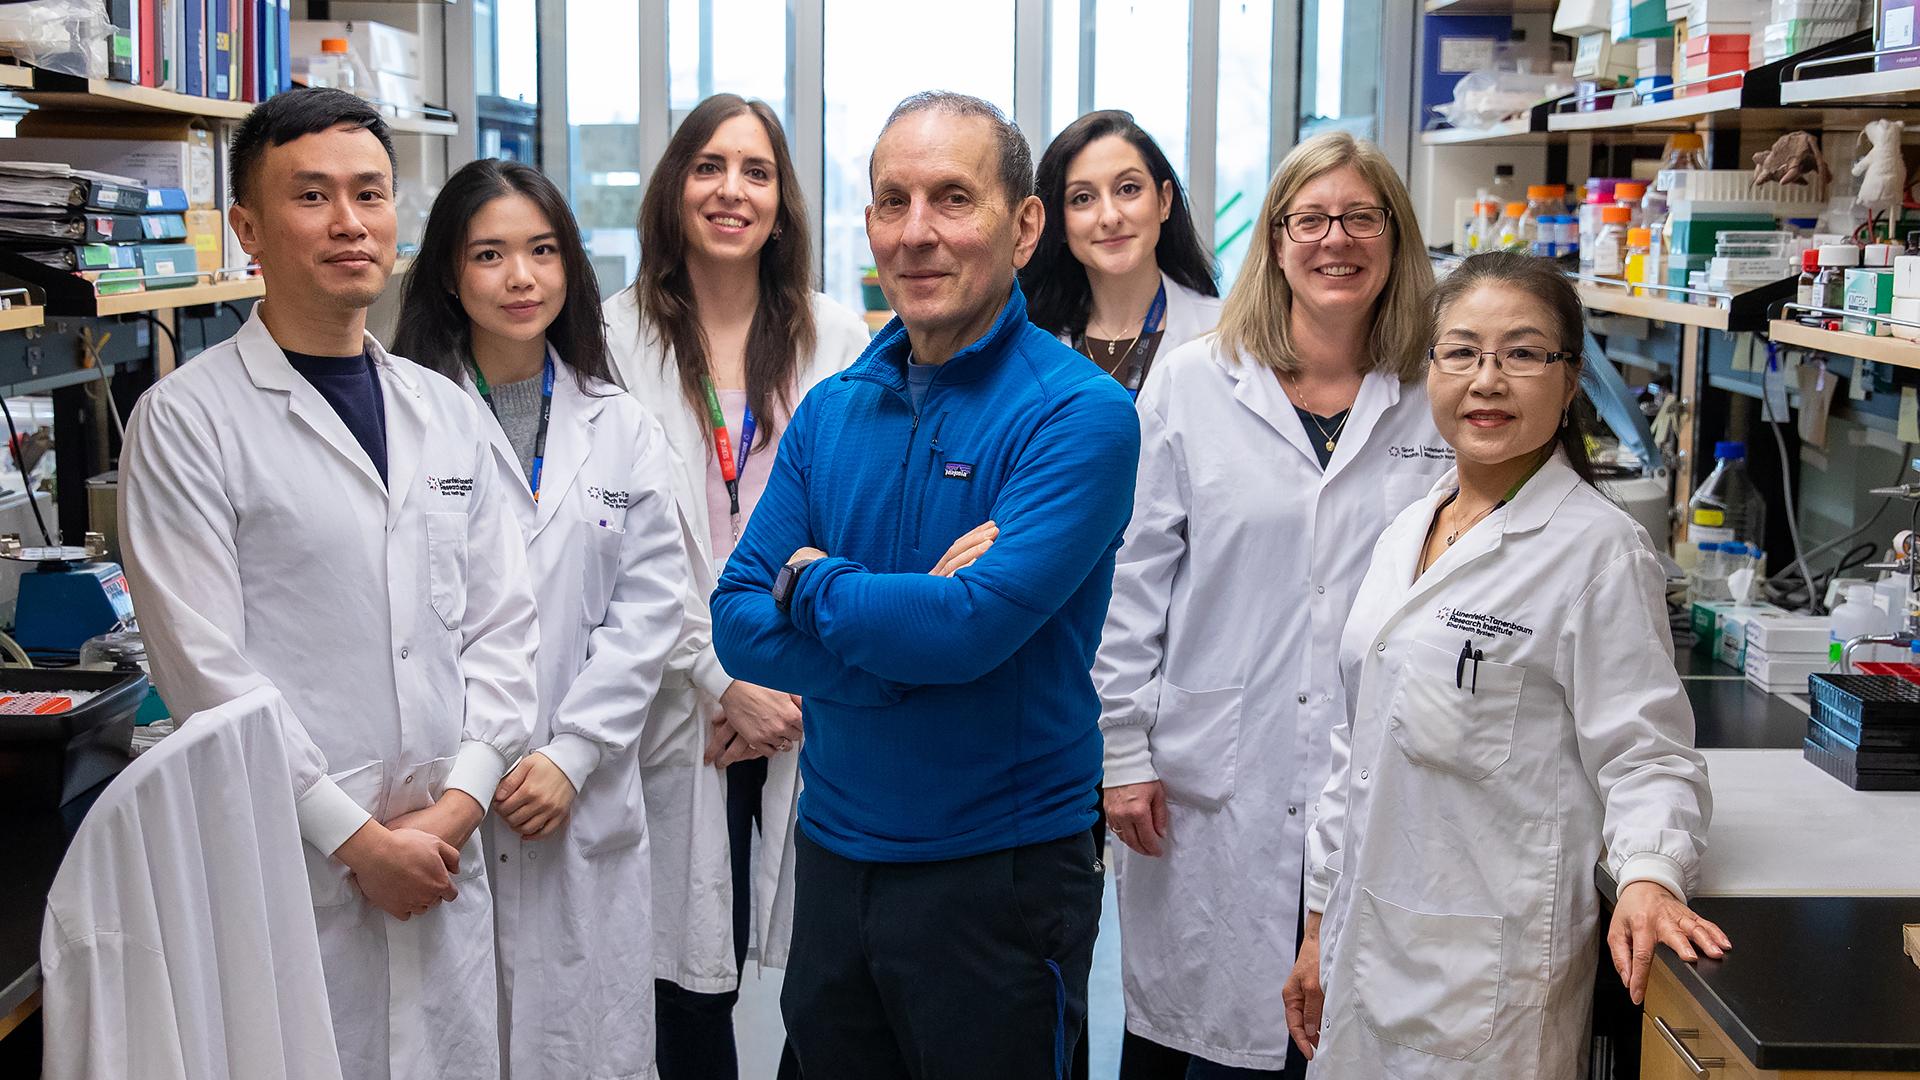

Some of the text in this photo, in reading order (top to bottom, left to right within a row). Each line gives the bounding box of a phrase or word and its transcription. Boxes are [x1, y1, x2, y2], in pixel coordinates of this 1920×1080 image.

[1448, 614, 1514, 637] Research Institute
[1451, 608, 1533, 636] Lunenfeld-Tanenbaum
